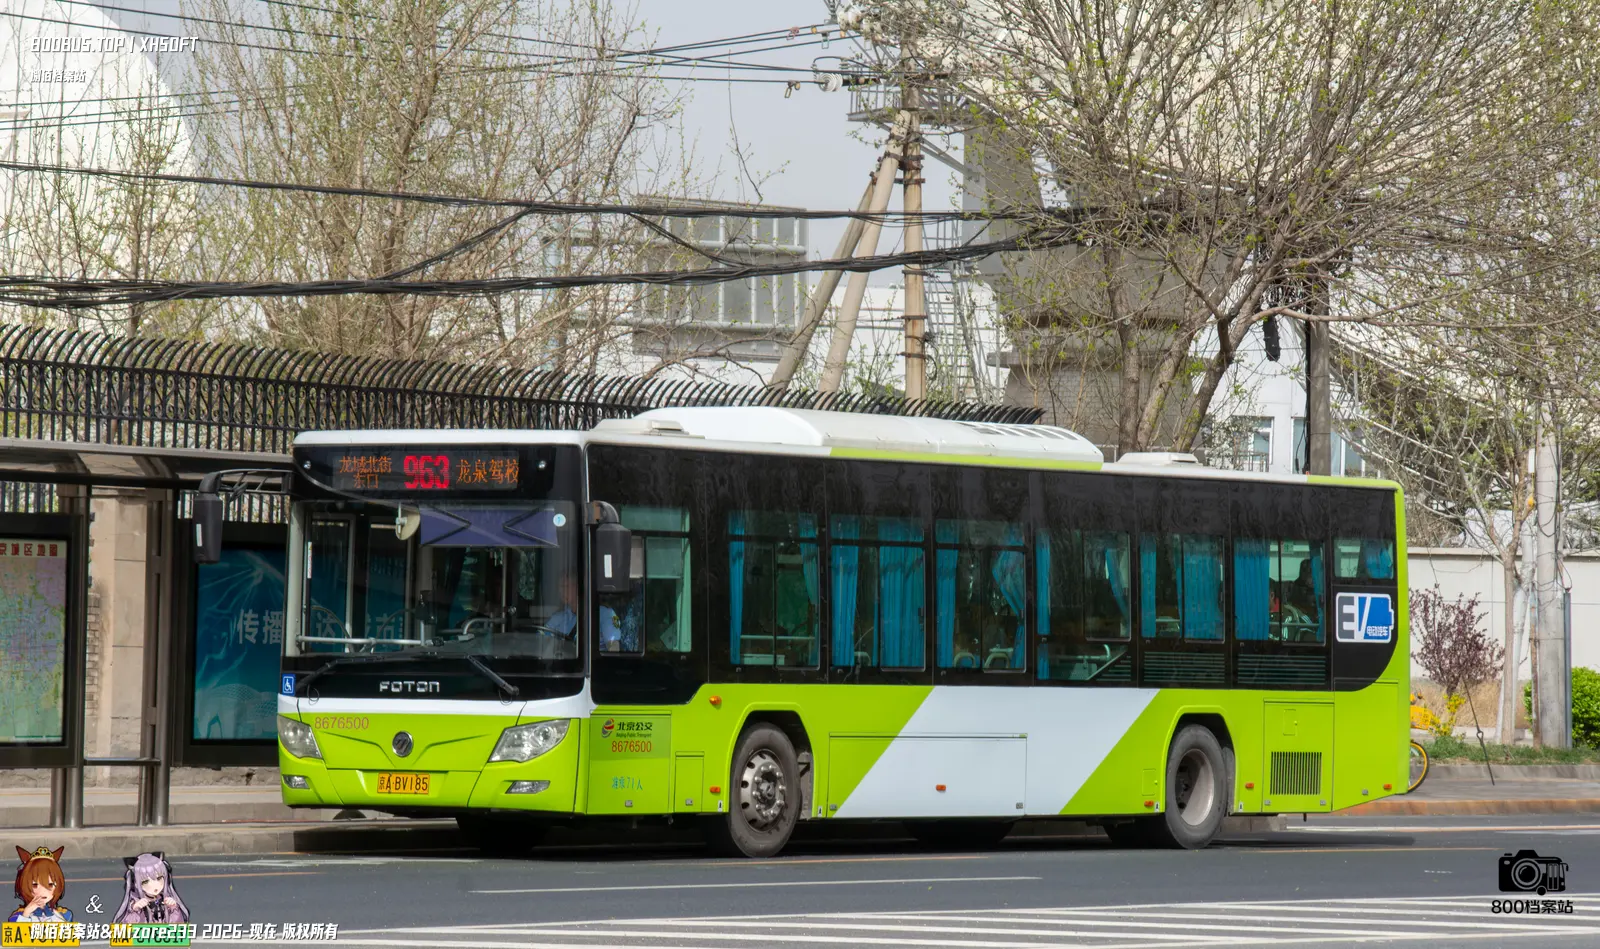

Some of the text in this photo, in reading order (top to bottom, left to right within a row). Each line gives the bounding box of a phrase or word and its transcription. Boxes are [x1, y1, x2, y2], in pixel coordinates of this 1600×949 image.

[403, 455, 450, 489] 963
[456, 459, 520, 484] 龙泉驾校
[379, 681, 440, 692] FOTON
[314, 716, 369, 730] 8676500
[616, 721, 653, 731] 北京公交
[612, 740, 652, 753] 8676500
